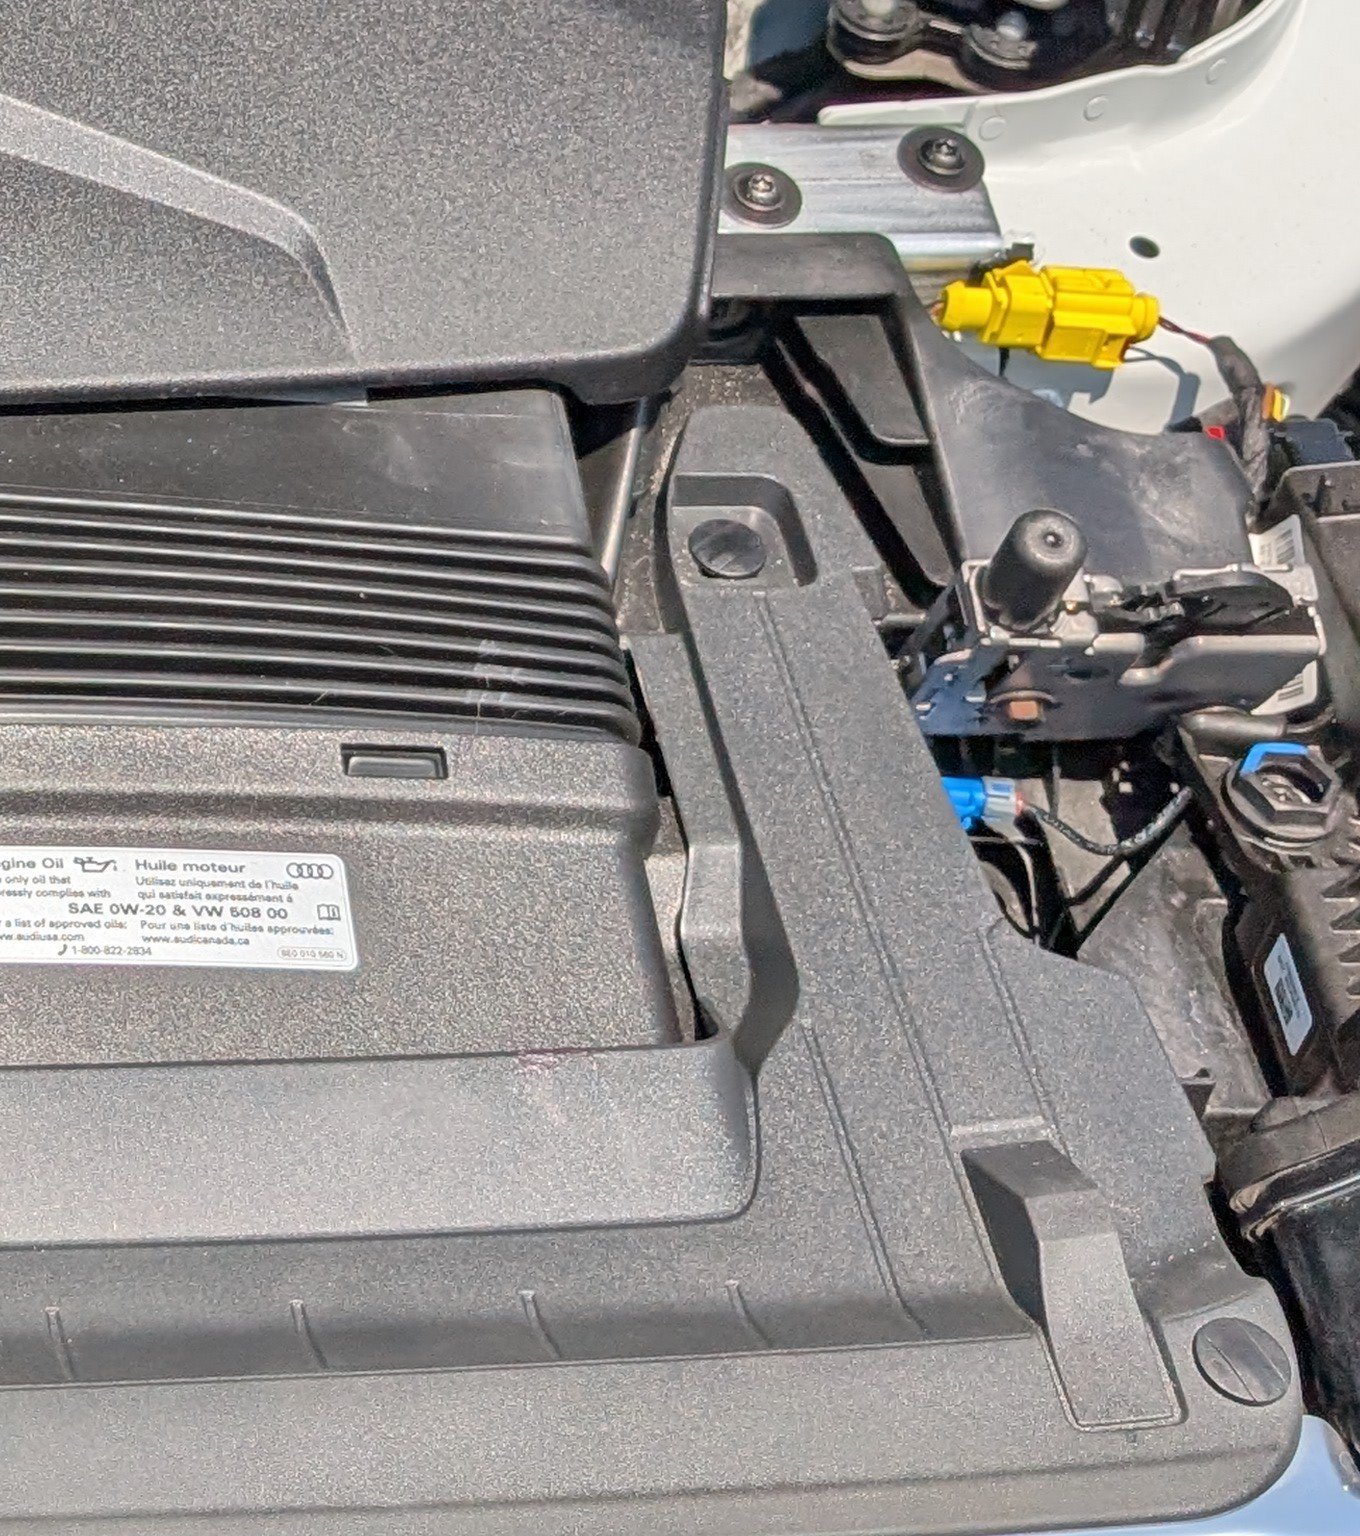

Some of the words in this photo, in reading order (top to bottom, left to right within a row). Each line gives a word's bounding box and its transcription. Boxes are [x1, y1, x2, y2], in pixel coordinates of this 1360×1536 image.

[41, 857, 65, 869] Oil
[135, 858, 178, 872] Huile
[182, 861, 246, 874] moteur
[4, 874, 29, 886] only
[31, 874, 46, 884] oil
[48, 874, 71, 884] that
[135, 875, 177, 887] Utilisez
[178, 877, 246, 891] uniquement
[249, 879, 263, 890] de
[264, 879, 300, 891] l'huile
[35, 888, 85, 899] complies
[87, 888, 112, 898] with
[137, 889, 156, 901] qui
[158, 890, 203, 901] satisfait
[205, 891, 284, 904] expressément
[67, 902, 104, 915] SAE
[109, 903, 167, 916] 0W-20
[172, 905, 187, 917] &
[191, 905, 224, 918] VW
[229, 906, 262, 919] 508
[266, 907, 289, 920] 00
[5, 920, 13, 928] a
[14, 917, 31, 928] list
[34, 917, 46, 928] of
[48, 919, 101, 931] approved
[103, 919, 128, 930] oils:
[140, 920, 166, 931] Pour
[169, 922, 191, 931] une
[193, 921, 217, 932] liste
[220, 921, 264, 934] d'huiles
[267, 923, 334, 937] approuvées:
[141, 934, 251, 946] www.audicanada.ca
[70, 945, 152, 956] 1-800-822-2834
